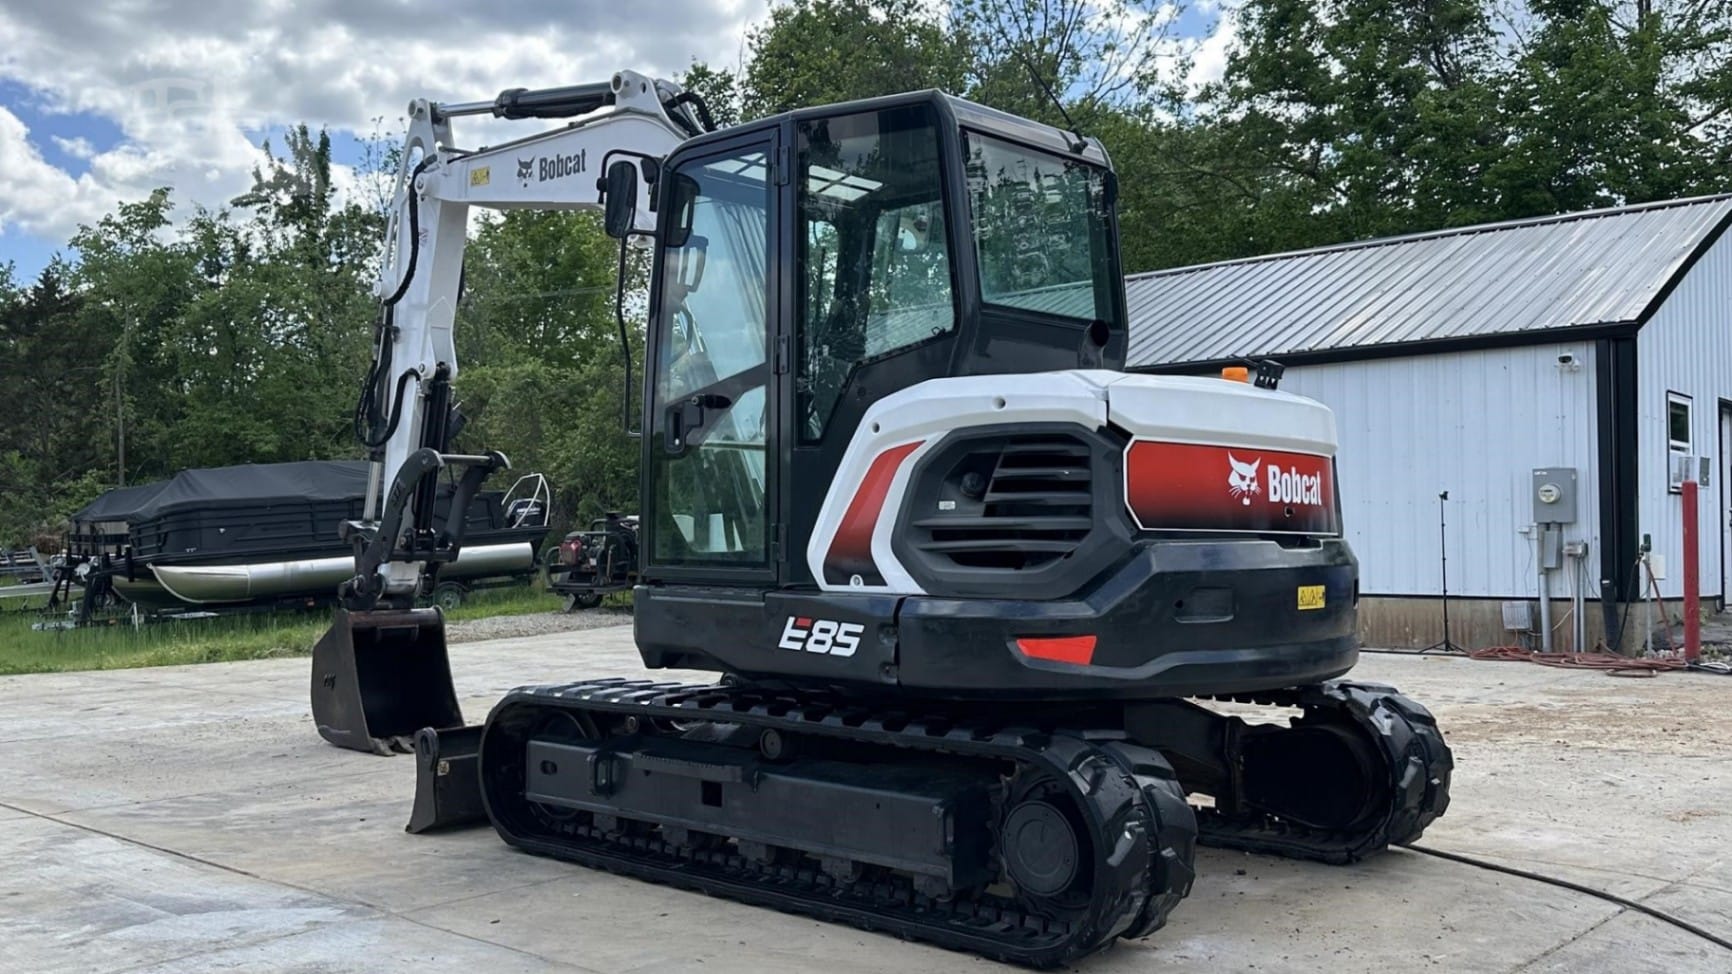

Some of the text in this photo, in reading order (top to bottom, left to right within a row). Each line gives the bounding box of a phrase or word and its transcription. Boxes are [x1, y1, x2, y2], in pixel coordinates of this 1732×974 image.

[539, 148, 586, 182] Bobcat
[1267, 464, 1322, 506] Bobcat
[778, 616, 865, 657] E85
